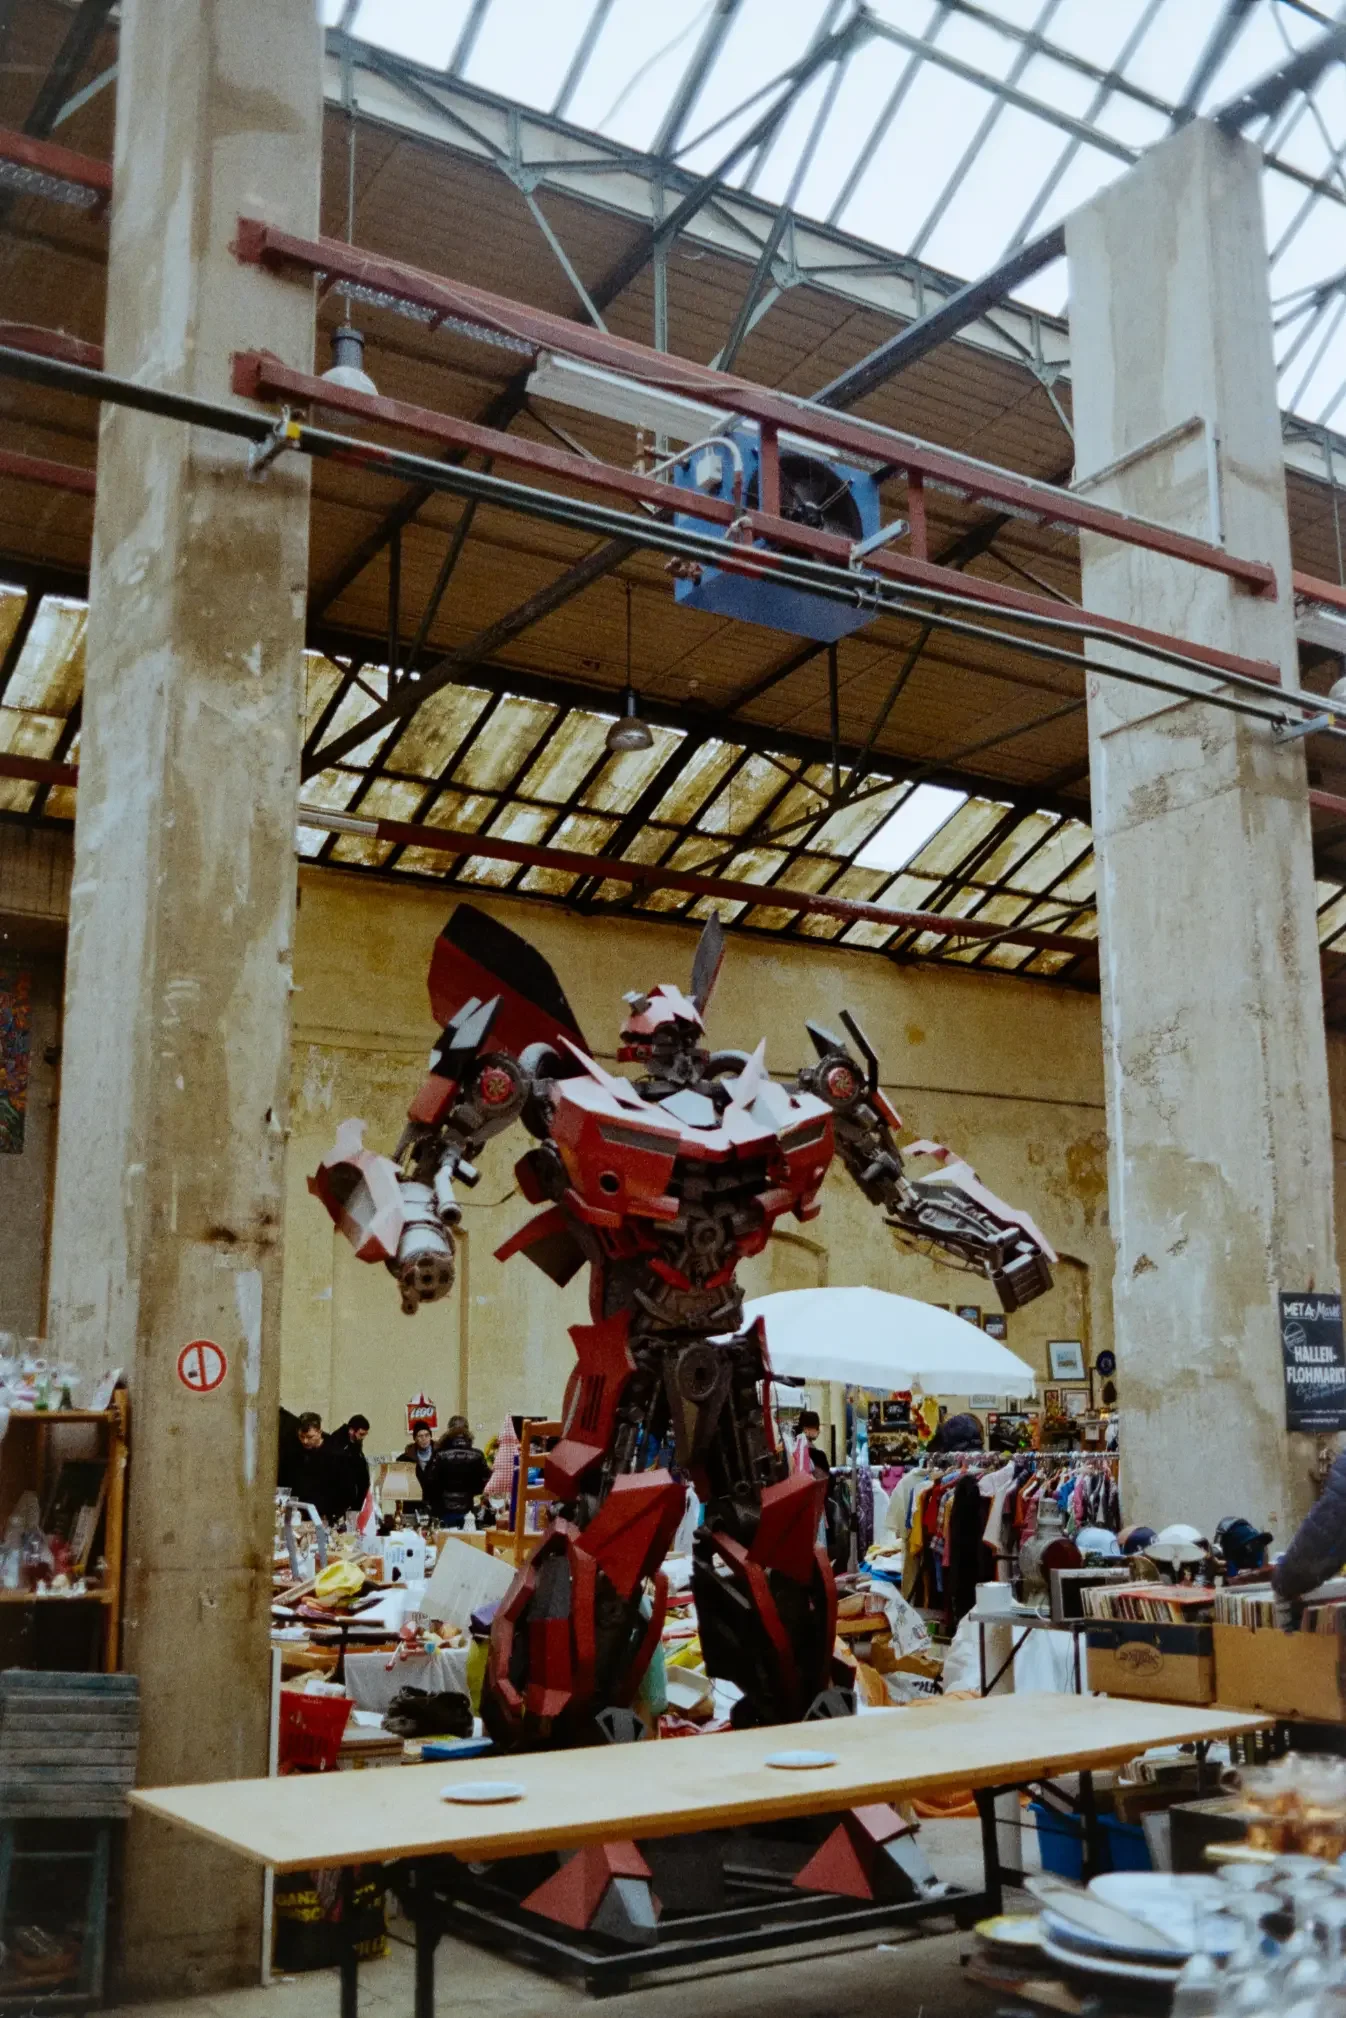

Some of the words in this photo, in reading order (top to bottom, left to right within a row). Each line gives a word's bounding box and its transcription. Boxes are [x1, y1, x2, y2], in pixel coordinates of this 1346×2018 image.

[1294, 1346, 1338, 1363] HALLEN-
[1286, 1366, 1346, 1384] FLOHMARKT
[410, 1407, 434, 1418] LEGO
